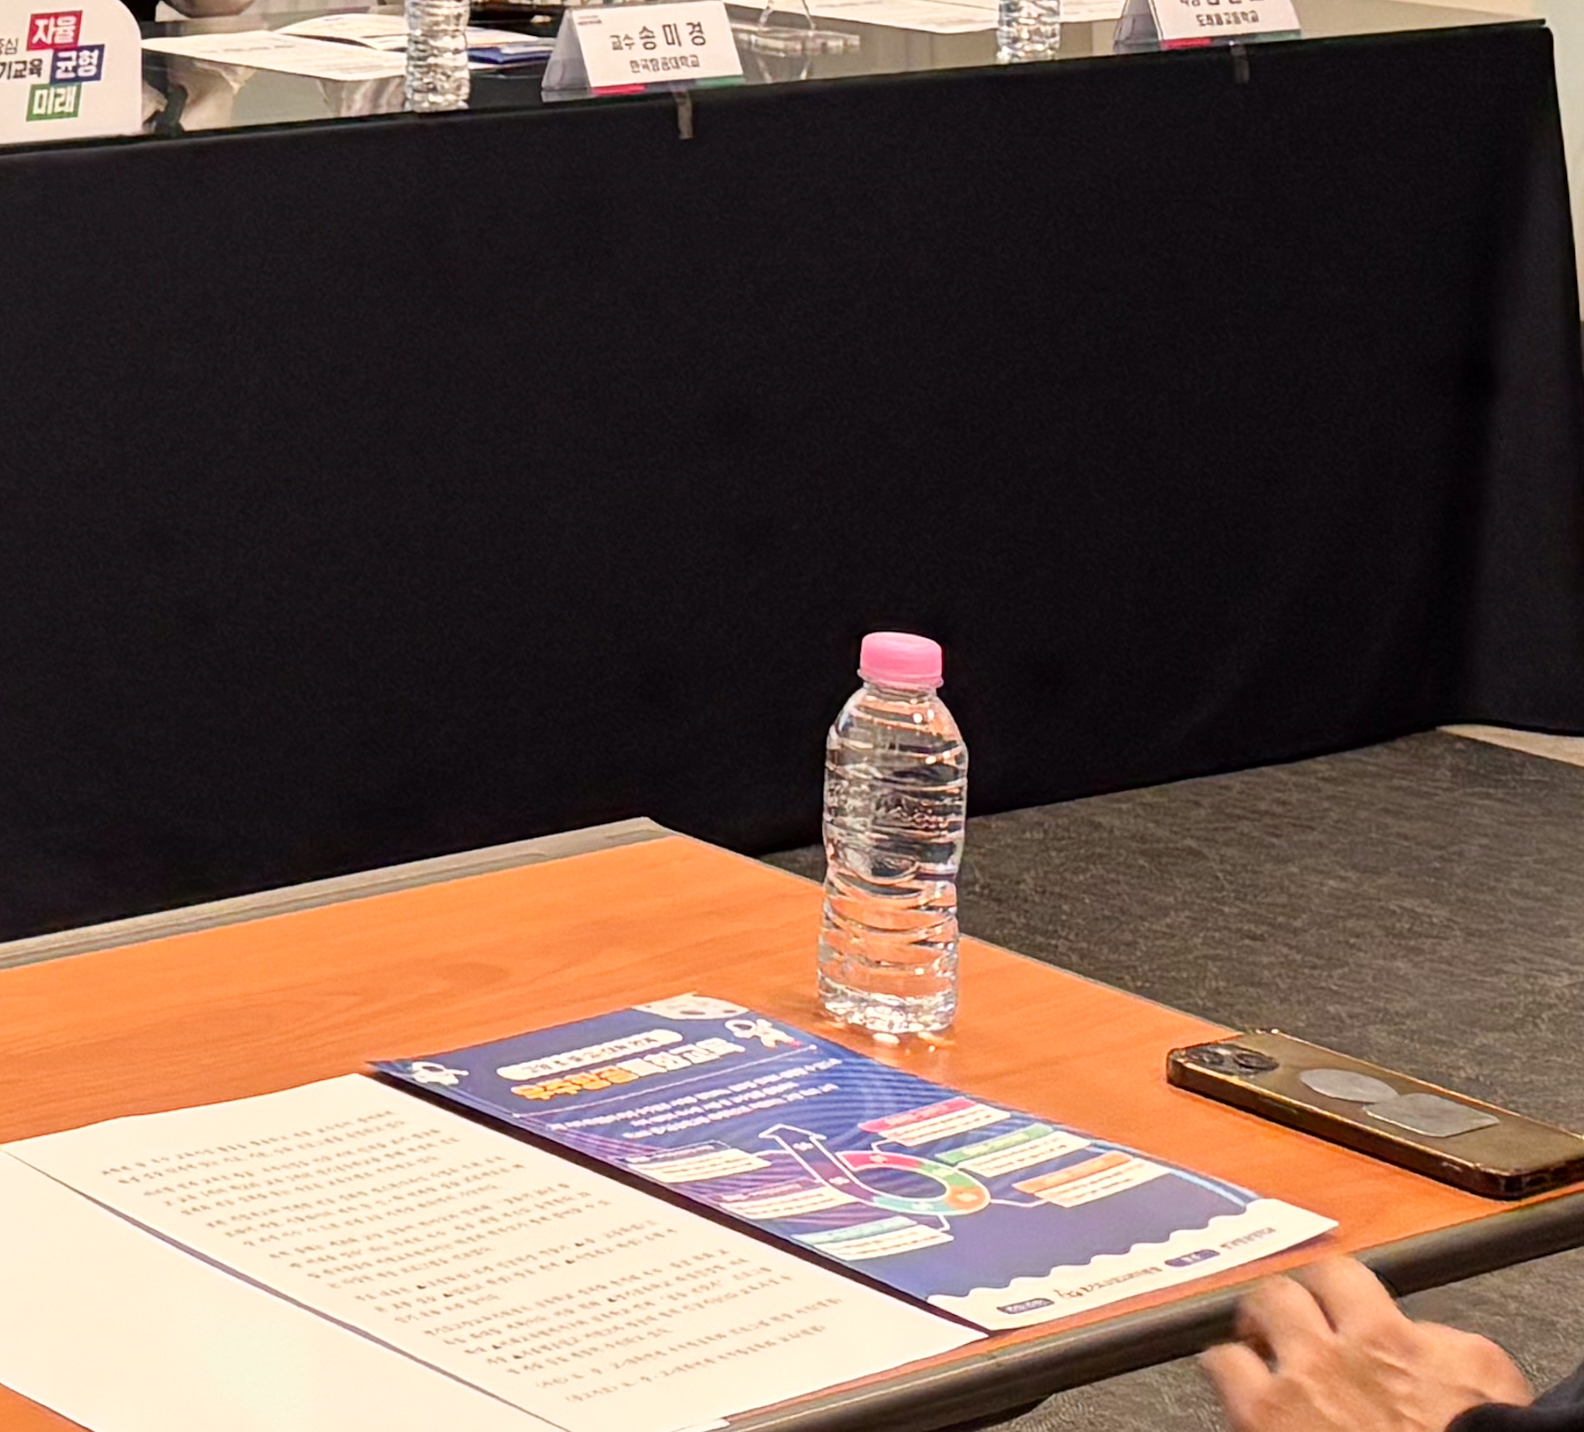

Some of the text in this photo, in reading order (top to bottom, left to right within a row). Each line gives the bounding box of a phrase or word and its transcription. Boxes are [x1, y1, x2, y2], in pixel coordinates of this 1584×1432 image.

[32, 16, 77, 45] 자율
[609, 33, 635, 51] 교수
[54, 50, 100, 80] 균형
[629, 54, 701, 73] 한국항공대학교
[32, 86, 78, 115] 미래
